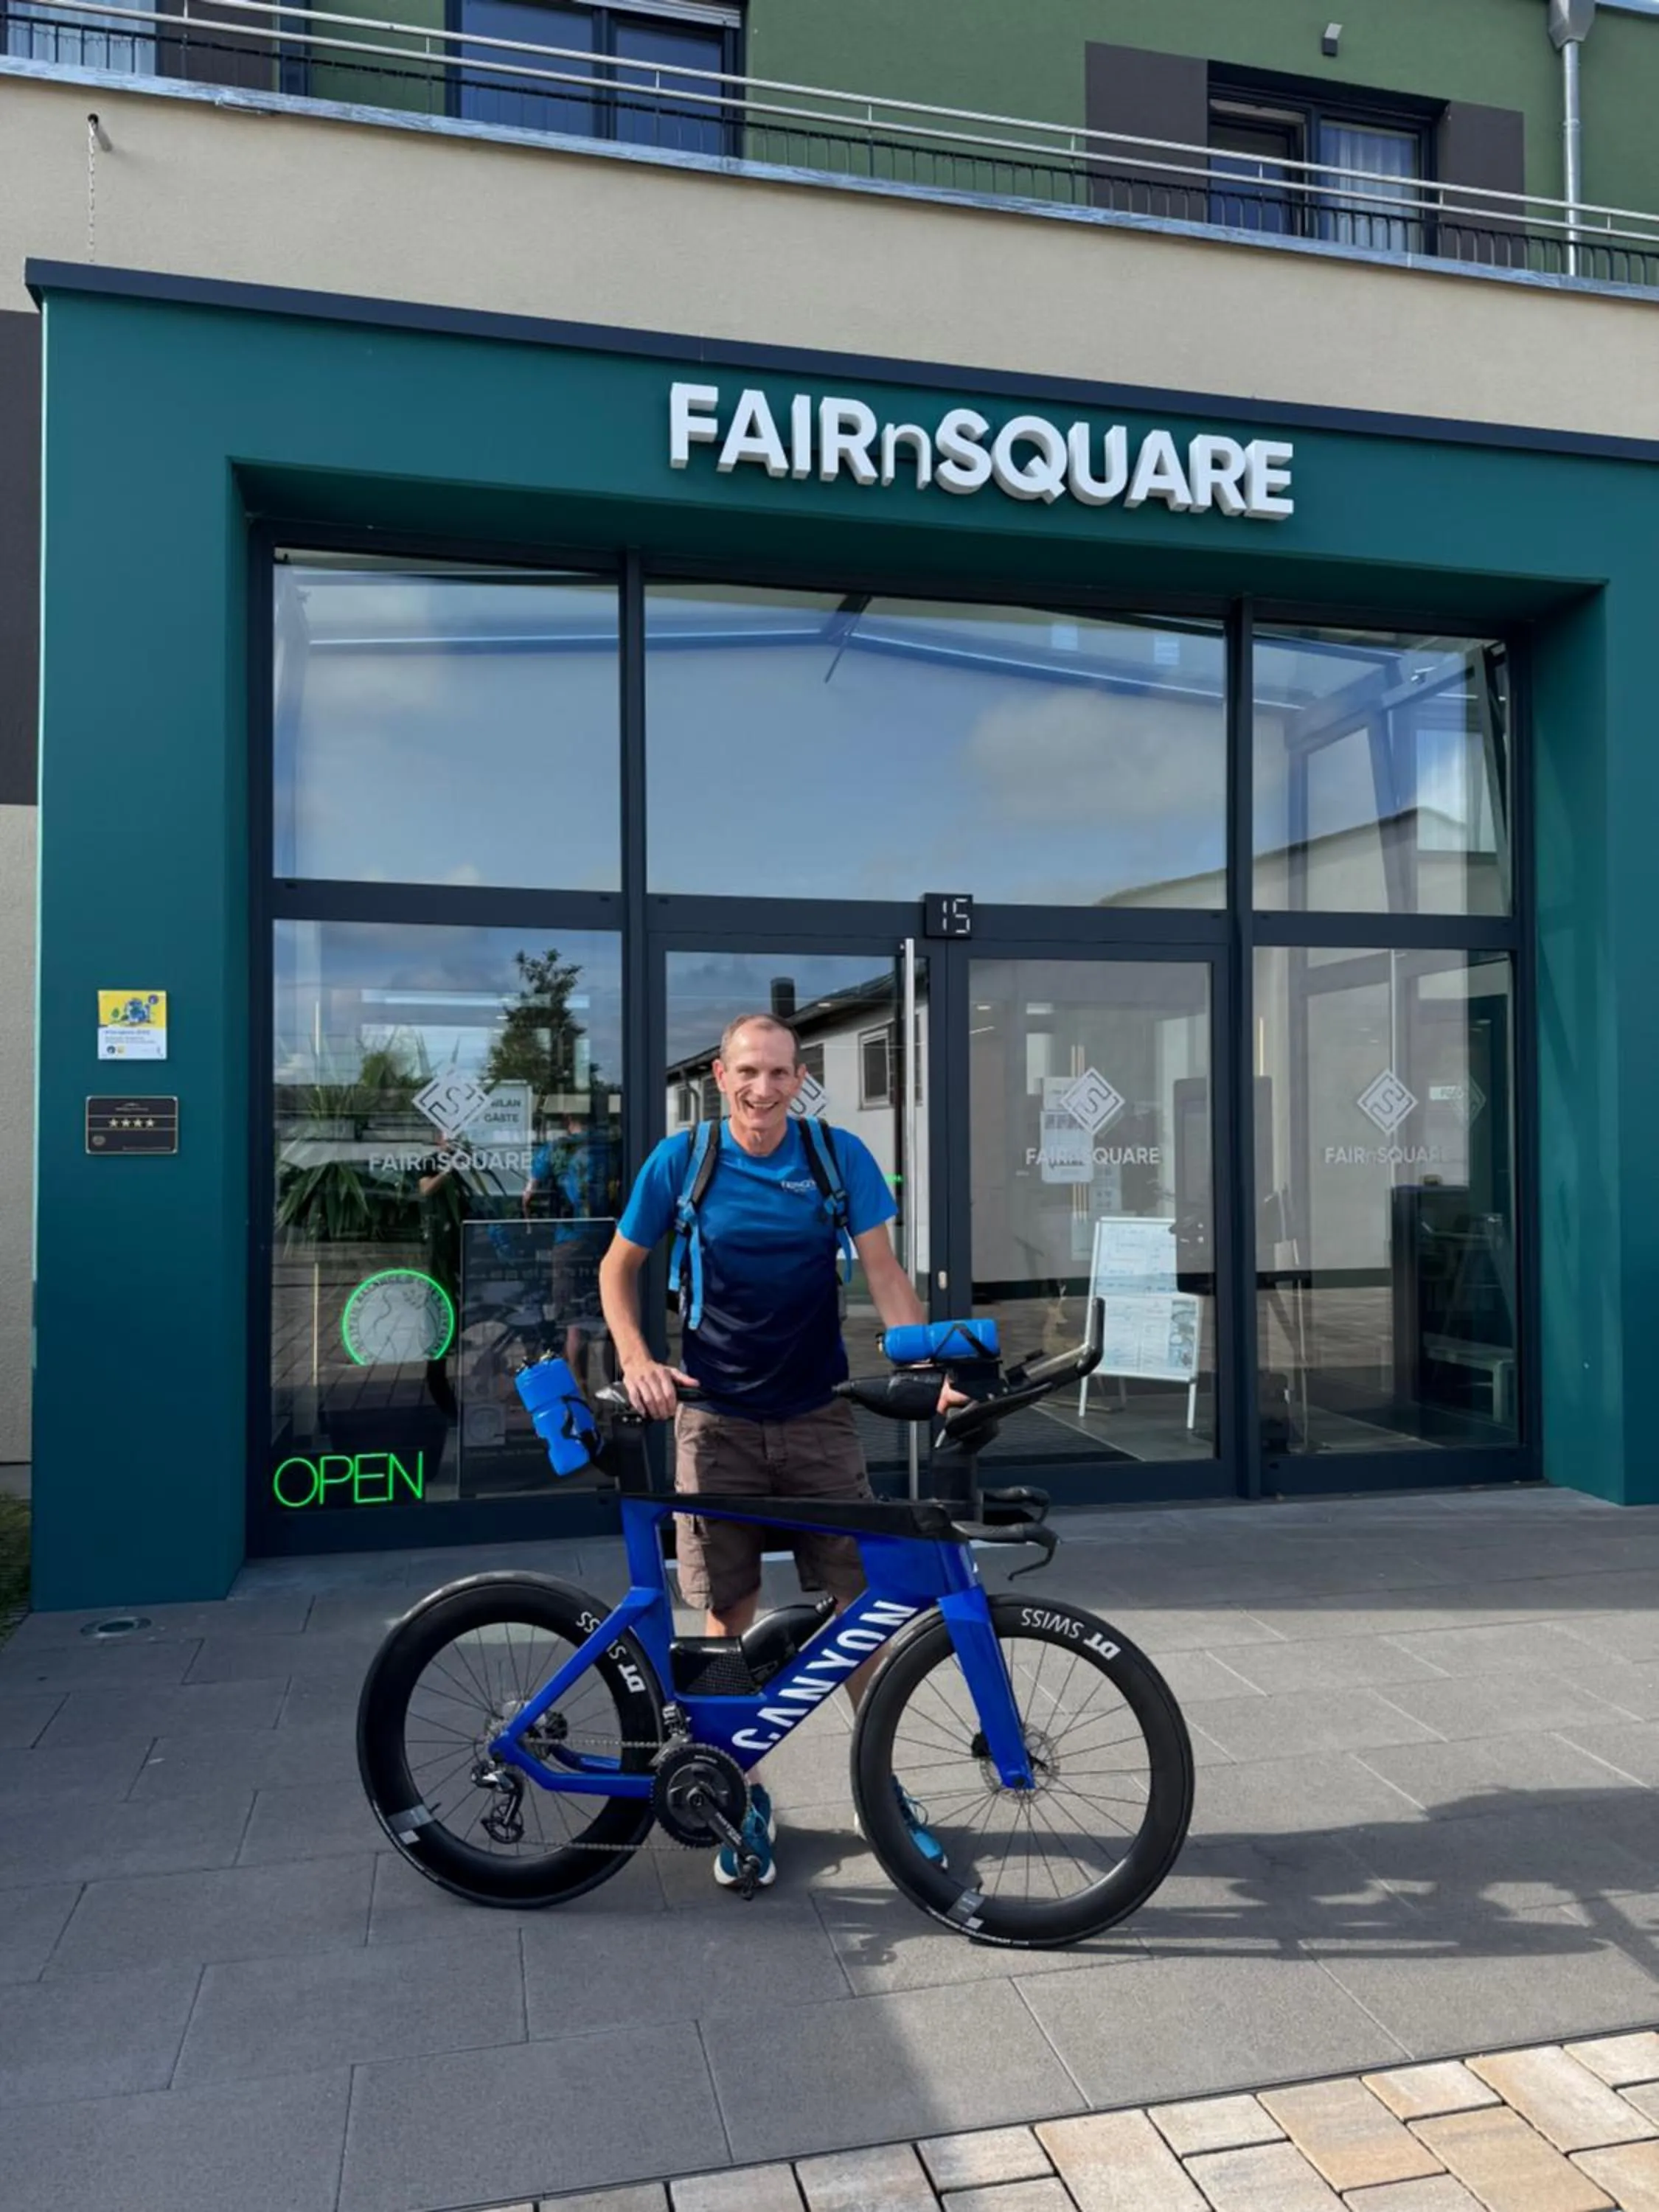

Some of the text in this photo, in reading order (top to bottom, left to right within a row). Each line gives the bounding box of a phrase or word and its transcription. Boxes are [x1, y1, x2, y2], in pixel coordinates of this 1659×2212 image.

[669, 382, 1294, 519] FAIRnSQUARE
[942, 898, 970, 934] 15
[369, 1151, 532, 1171] FAIRnSQUARE
[274, 1451, 423, 1507] OPEN
[575, 1611, 646, 1694] DT SSS
[1021, 1607, 1121, 1660] DT SWISS
[731, 1599, 919, 1750] CANYON
